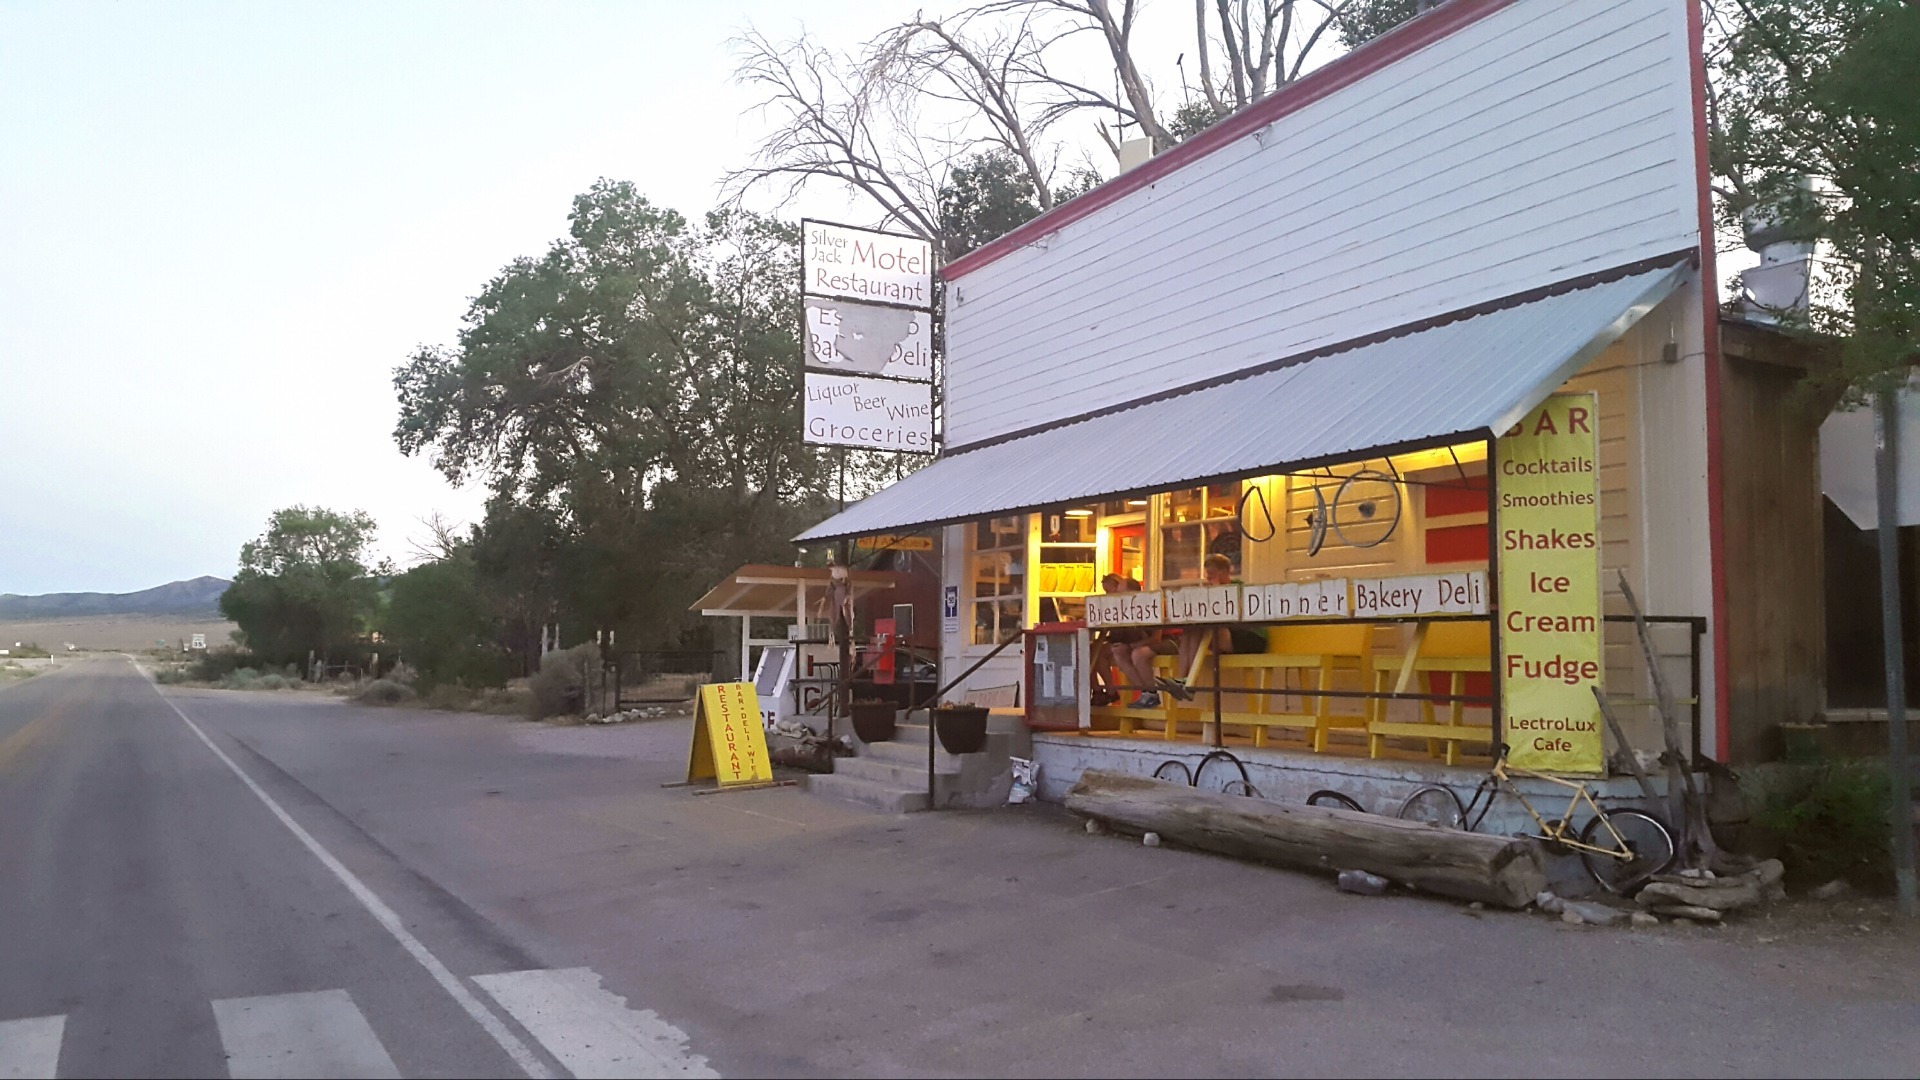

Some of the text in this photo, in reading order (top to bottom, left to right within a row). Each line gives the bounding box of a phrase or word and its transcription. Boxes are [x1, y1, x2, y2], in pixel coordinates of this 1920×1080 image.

[811, 229, 849, 249] Silver
[811, 246, 842, 264] Jack
[852, 240, 927, 275] Motel
[816, 267, 923, 301] Restaurant
[807, 382, 860, 405] Liquor
[853, 395, 886, 412] Beer
[886, 402, 929, 421] Wine
[809, 417, 928, 446] Groceries
[1502, 456, 1593, 476] Cocktails
[1502, 490, 1595, 507] Smoothies
[1504, 528, 1596, 551] Shakes
[1530, 572, 1570, 593] Ice
[1088, 573, 1480, 623] Breakfast Lunch Dinner Bakery Deli
[1506, 611, 1595, 632] Cream
[1507, 654, 1599, 685] Fudge
[717, 685, 741, 780] RESTAURANT
[741, 712, 750, 741] DELI
[1509, 716, 1596, 732] LectroLux
[1533, 737, 1572, 751] Cafe
